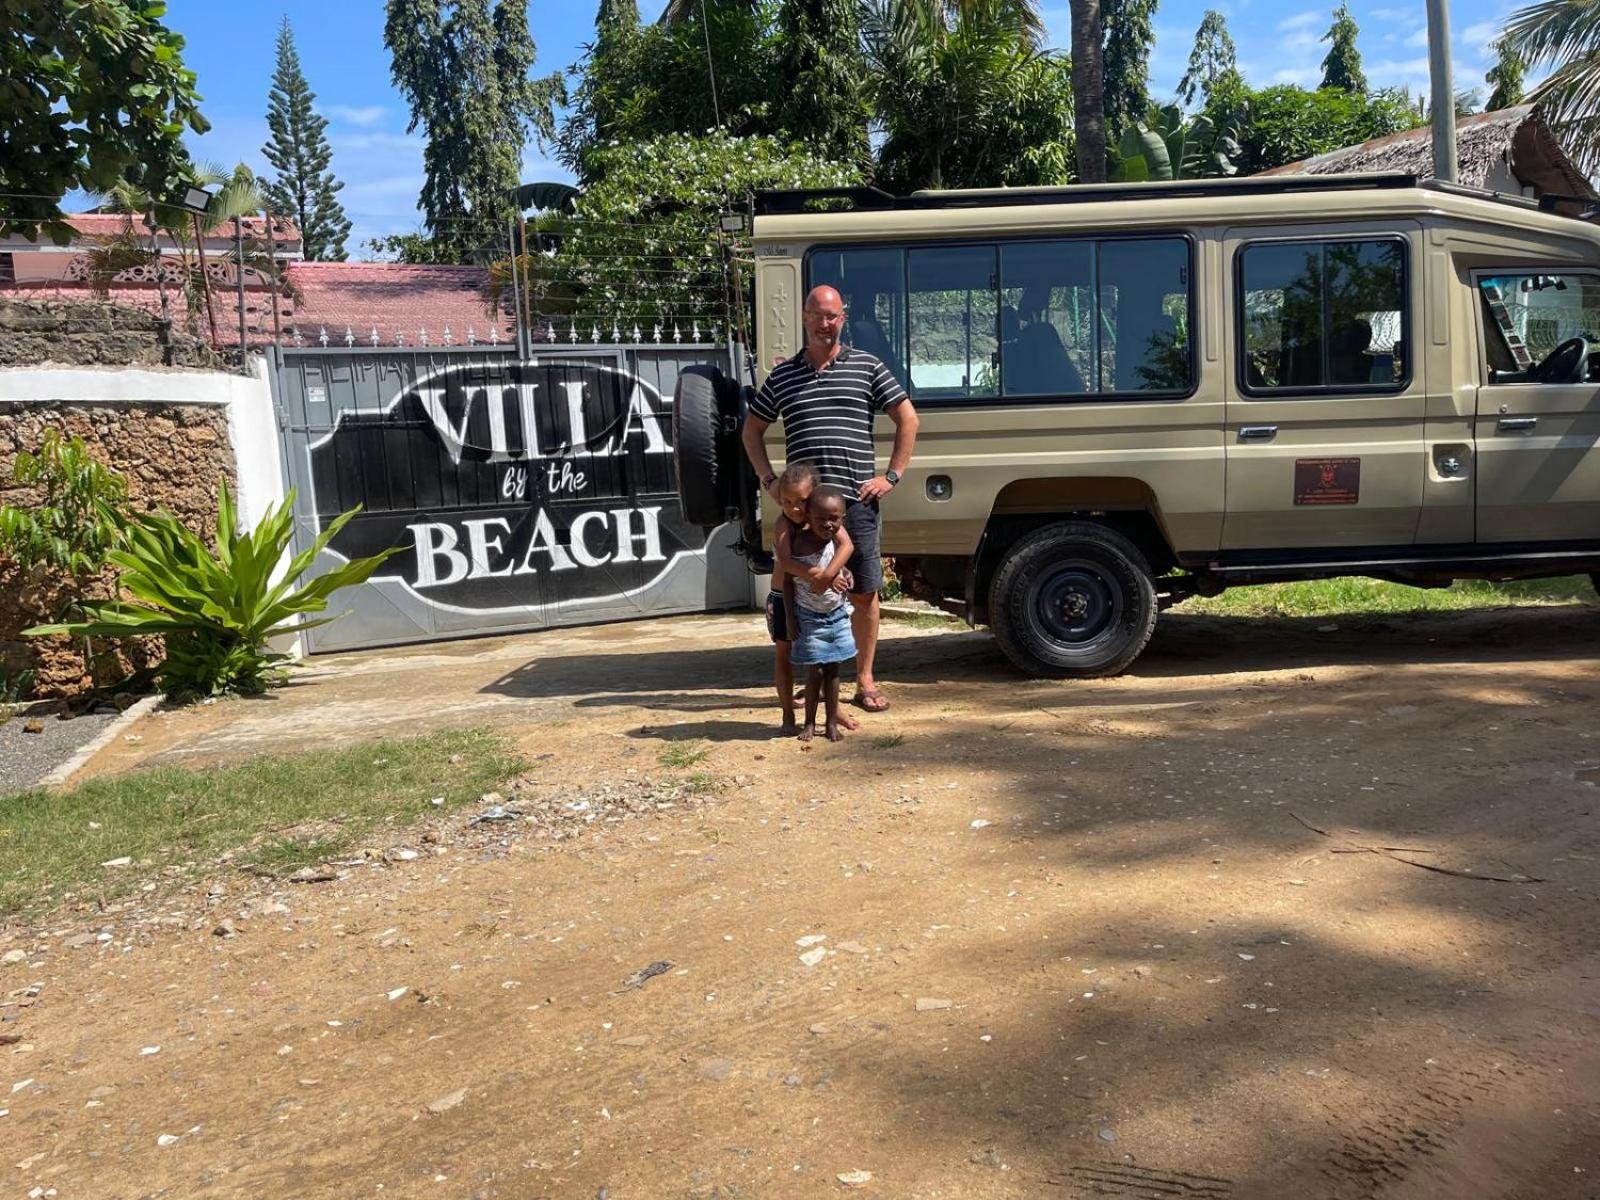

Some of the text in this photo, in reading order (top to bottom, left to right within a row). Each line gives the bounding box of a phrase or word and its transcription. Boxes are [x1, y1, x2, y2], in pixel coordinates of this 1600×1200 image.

[410, 381, 674, 464] VILLA
[502, 462, 588, 498] by the
[406, 506, 667, 588] BEACH
